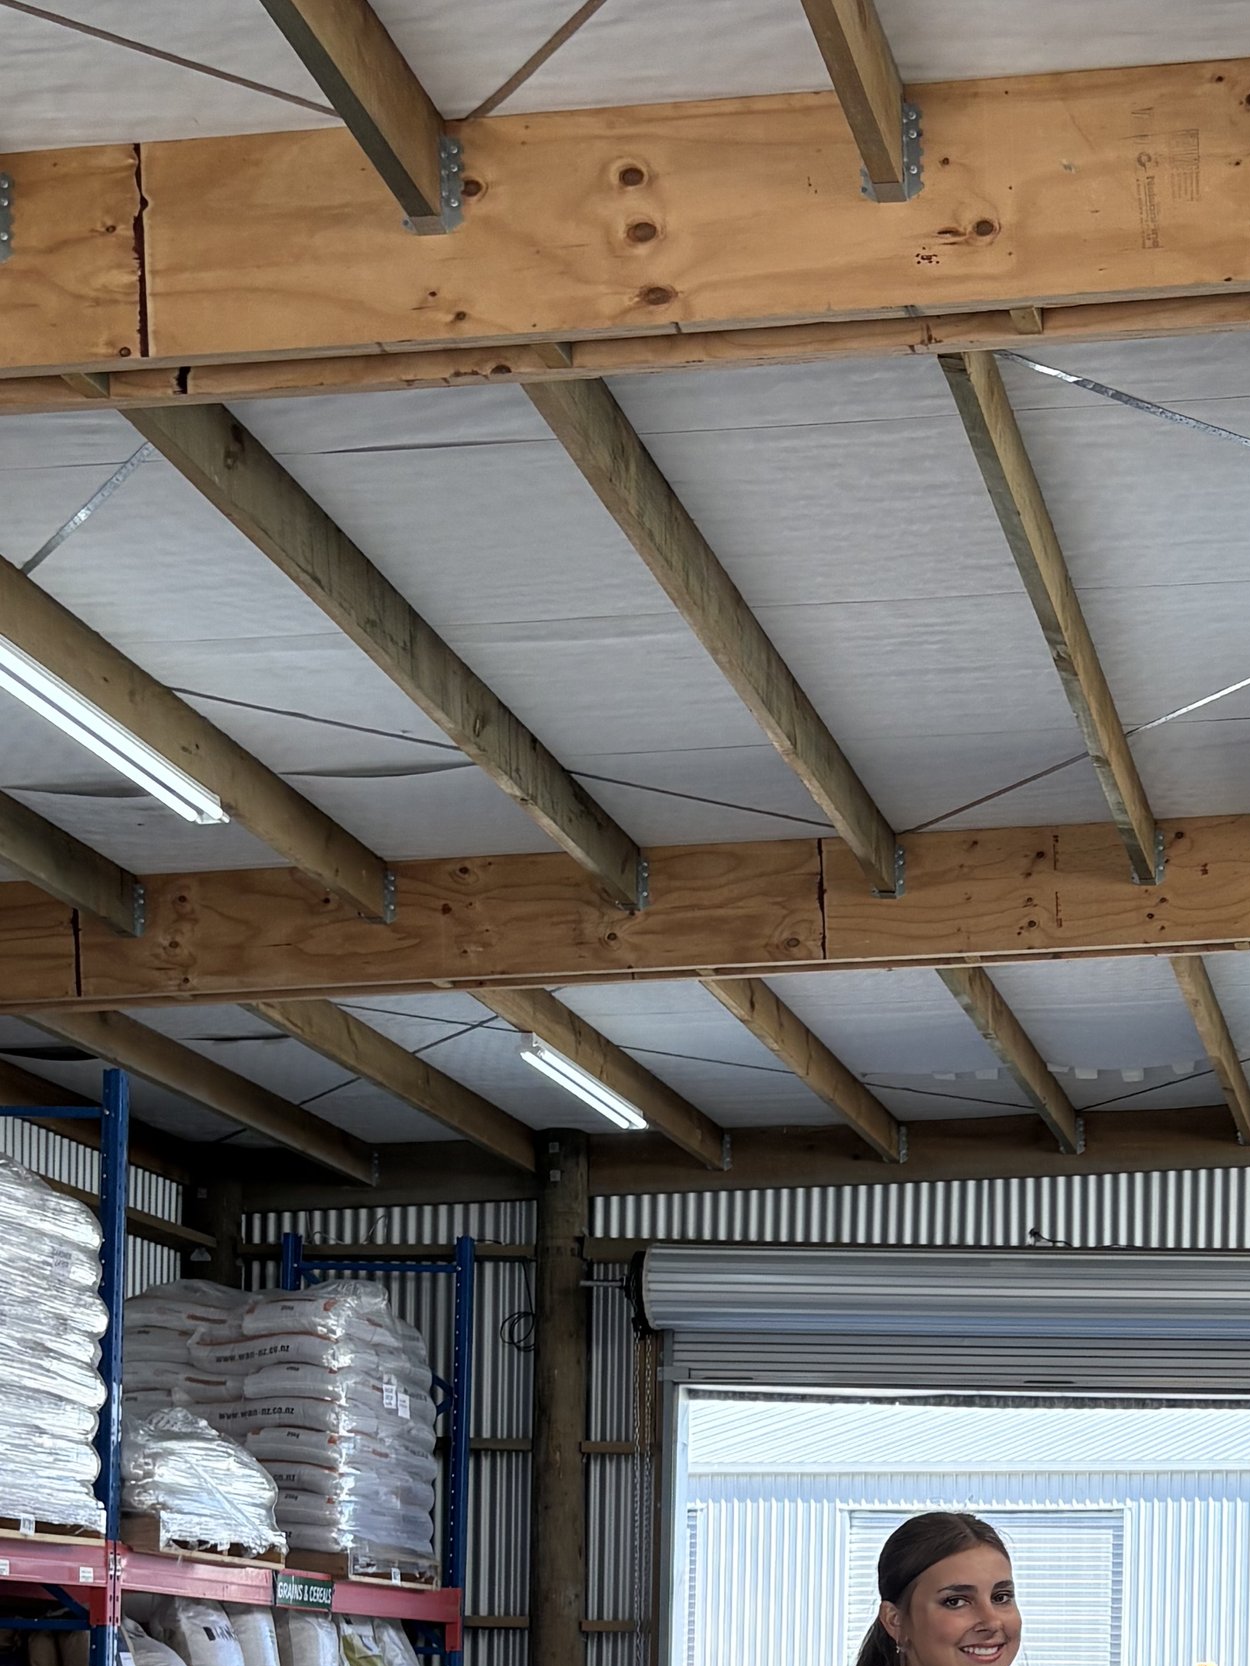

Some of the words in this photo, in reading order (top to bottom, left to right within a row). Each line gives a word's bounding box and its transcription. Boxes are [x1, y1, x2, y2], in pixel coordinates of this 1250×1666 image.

[278, 1582, 303, 1600] GRAINS
[304, 1585, 308, 1601] &
[309, 1586, 331, 1603] CEREALS
